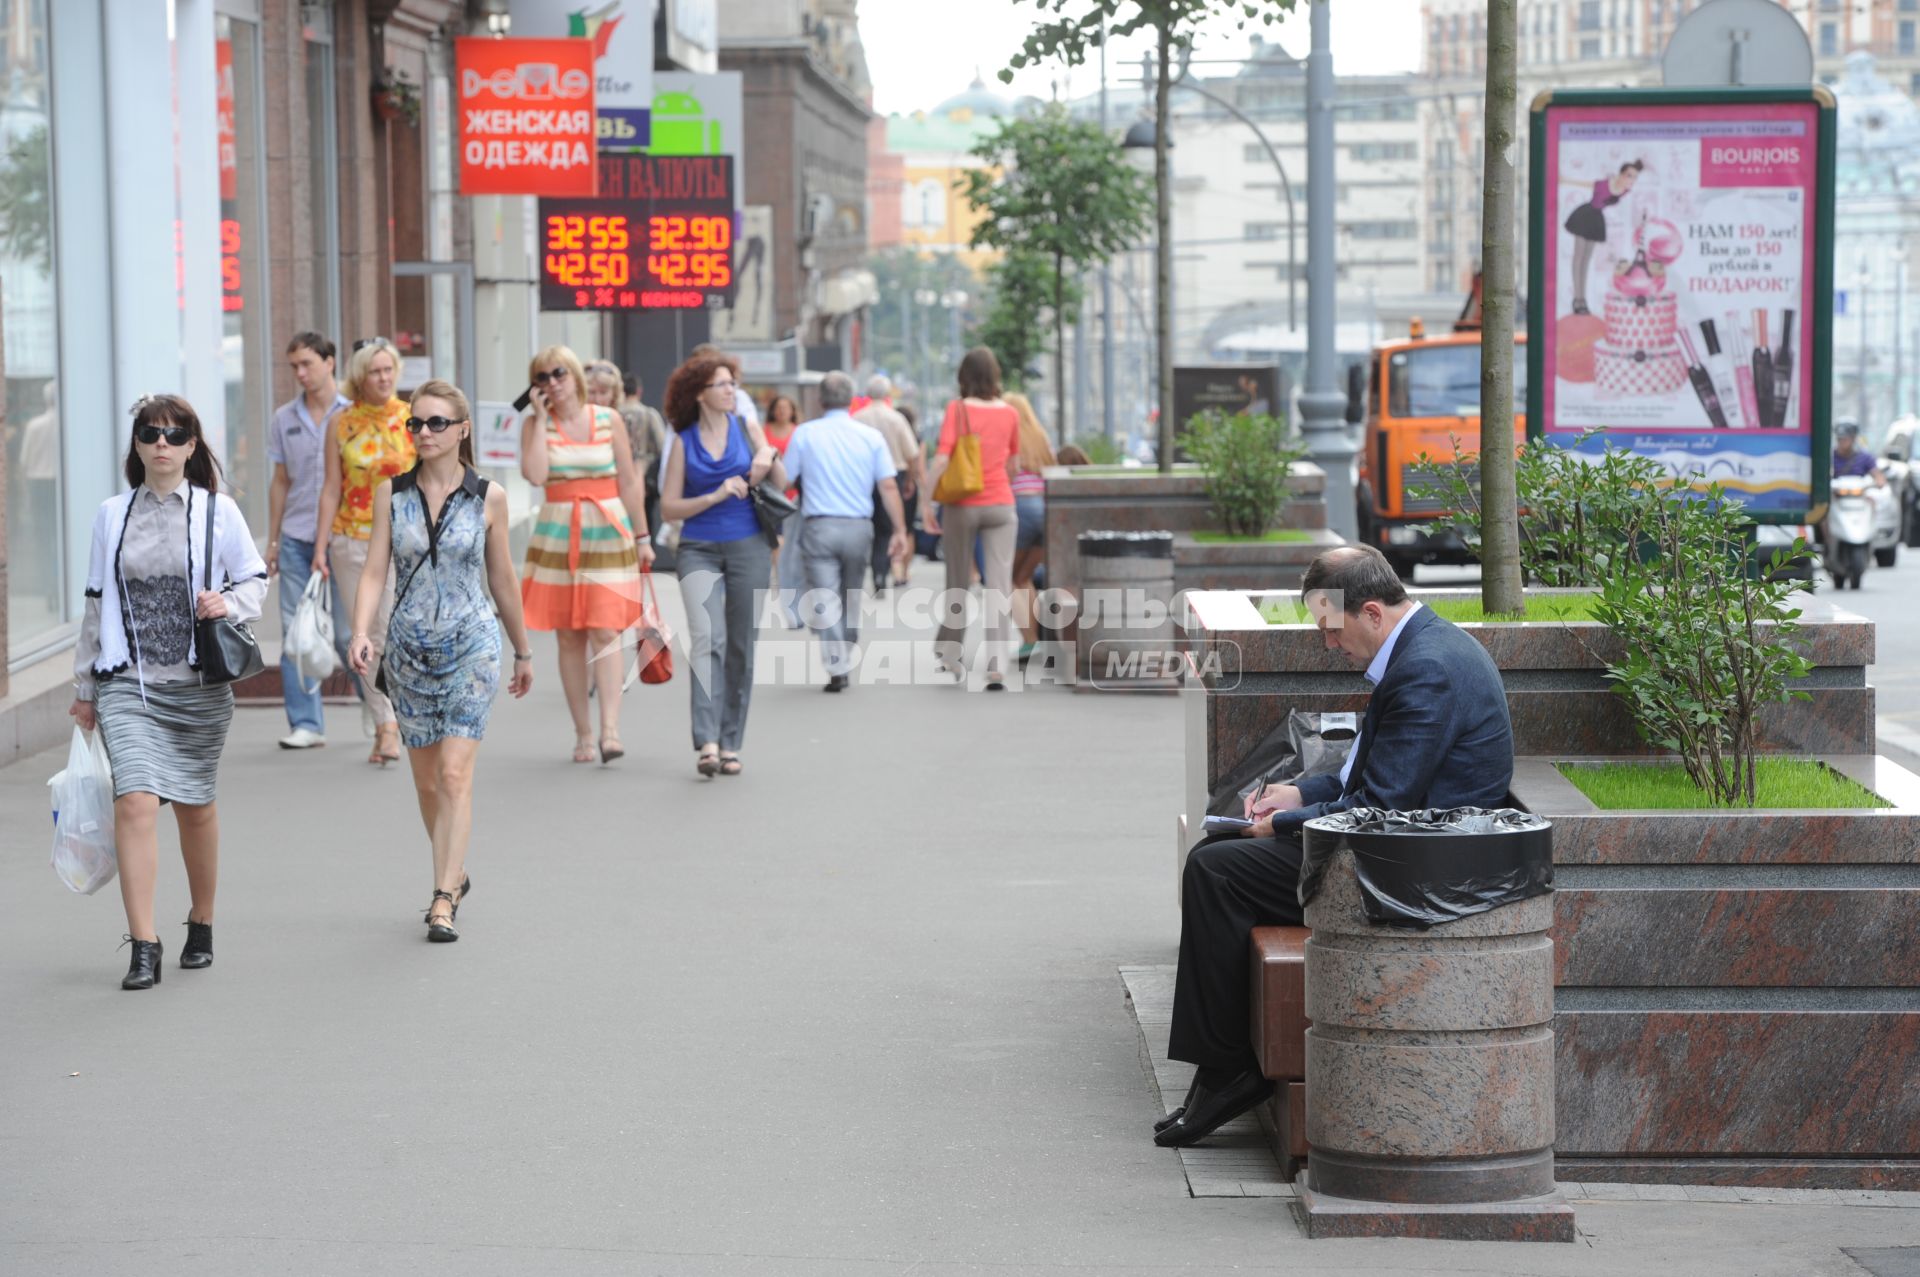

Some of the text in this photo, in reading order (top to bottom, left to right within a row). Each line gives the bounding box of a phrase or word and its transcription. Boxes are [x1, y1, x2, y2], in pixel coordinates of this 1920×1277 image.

[466, 110, 590, 135] ЖЕНСКАЯ
[465, 140, 590, 169] ОДЕЖДА
[1711, 147, 1800, 165] BOURJOIS
[629, 158, 727, 199] ВАЛЮТЫ
[649, 217, 730, 250] 32.90
[1689, 224, 1797, 238] НАМ 150 лет!
[1700, 242, 1782, 256] Вам до 150
[546, 253, 730, 286] 42.50 42.95
[1709, 260, 1759, 275] рублей
